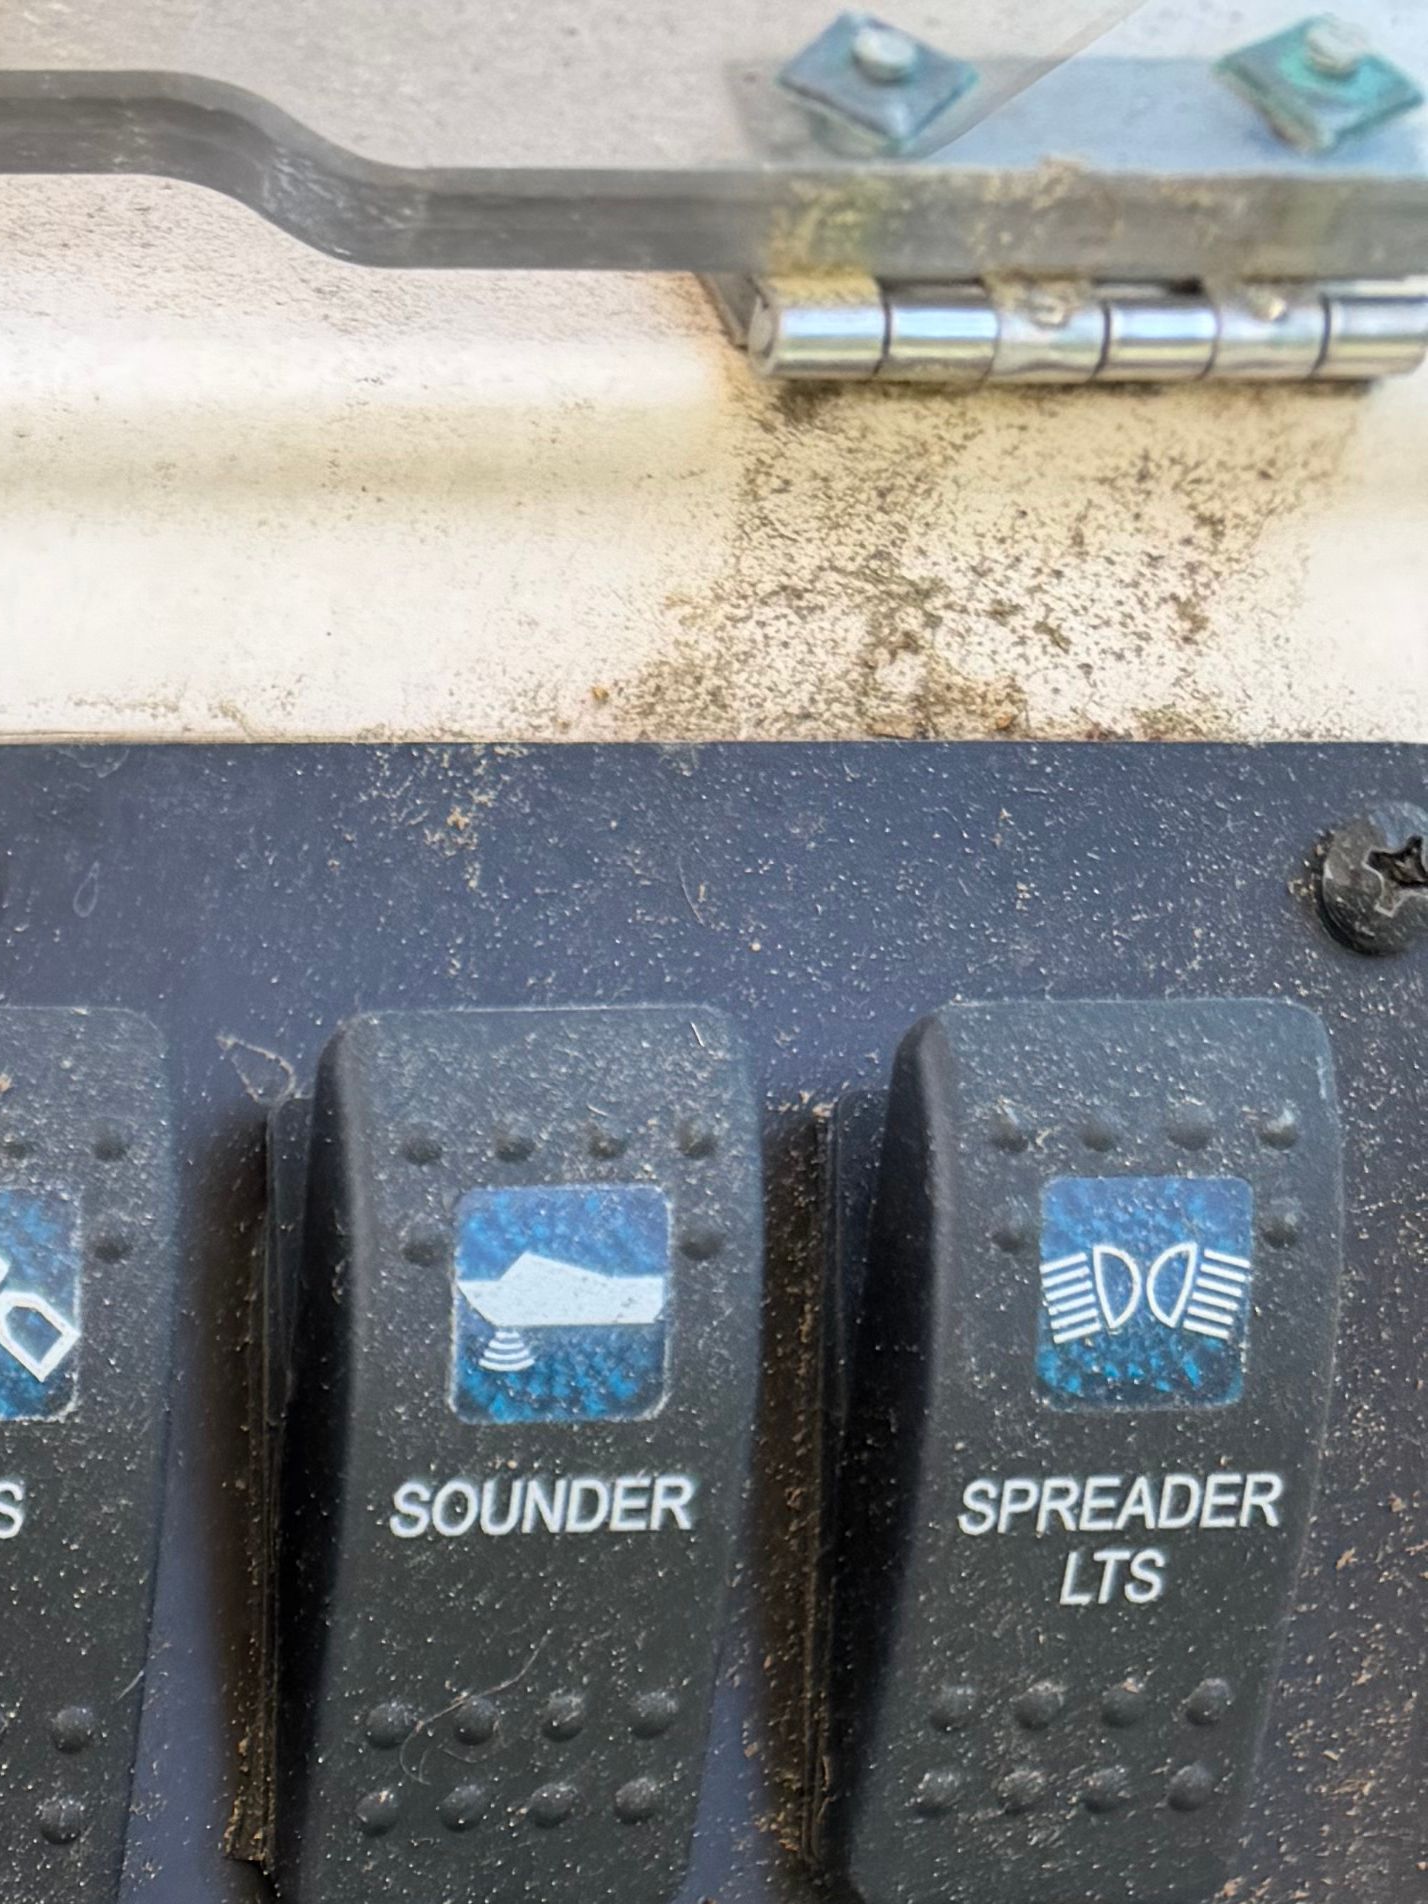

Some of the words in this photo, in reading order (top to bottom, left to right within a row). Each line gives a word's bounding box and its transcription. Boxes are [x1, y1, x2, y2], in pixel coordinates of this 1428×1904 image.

[390, 1473, 694, 1540] SOUNDER
[957, 1471, 1284, 1539] SPREADER
[1058, 1548, 1167, 1607] LTS
